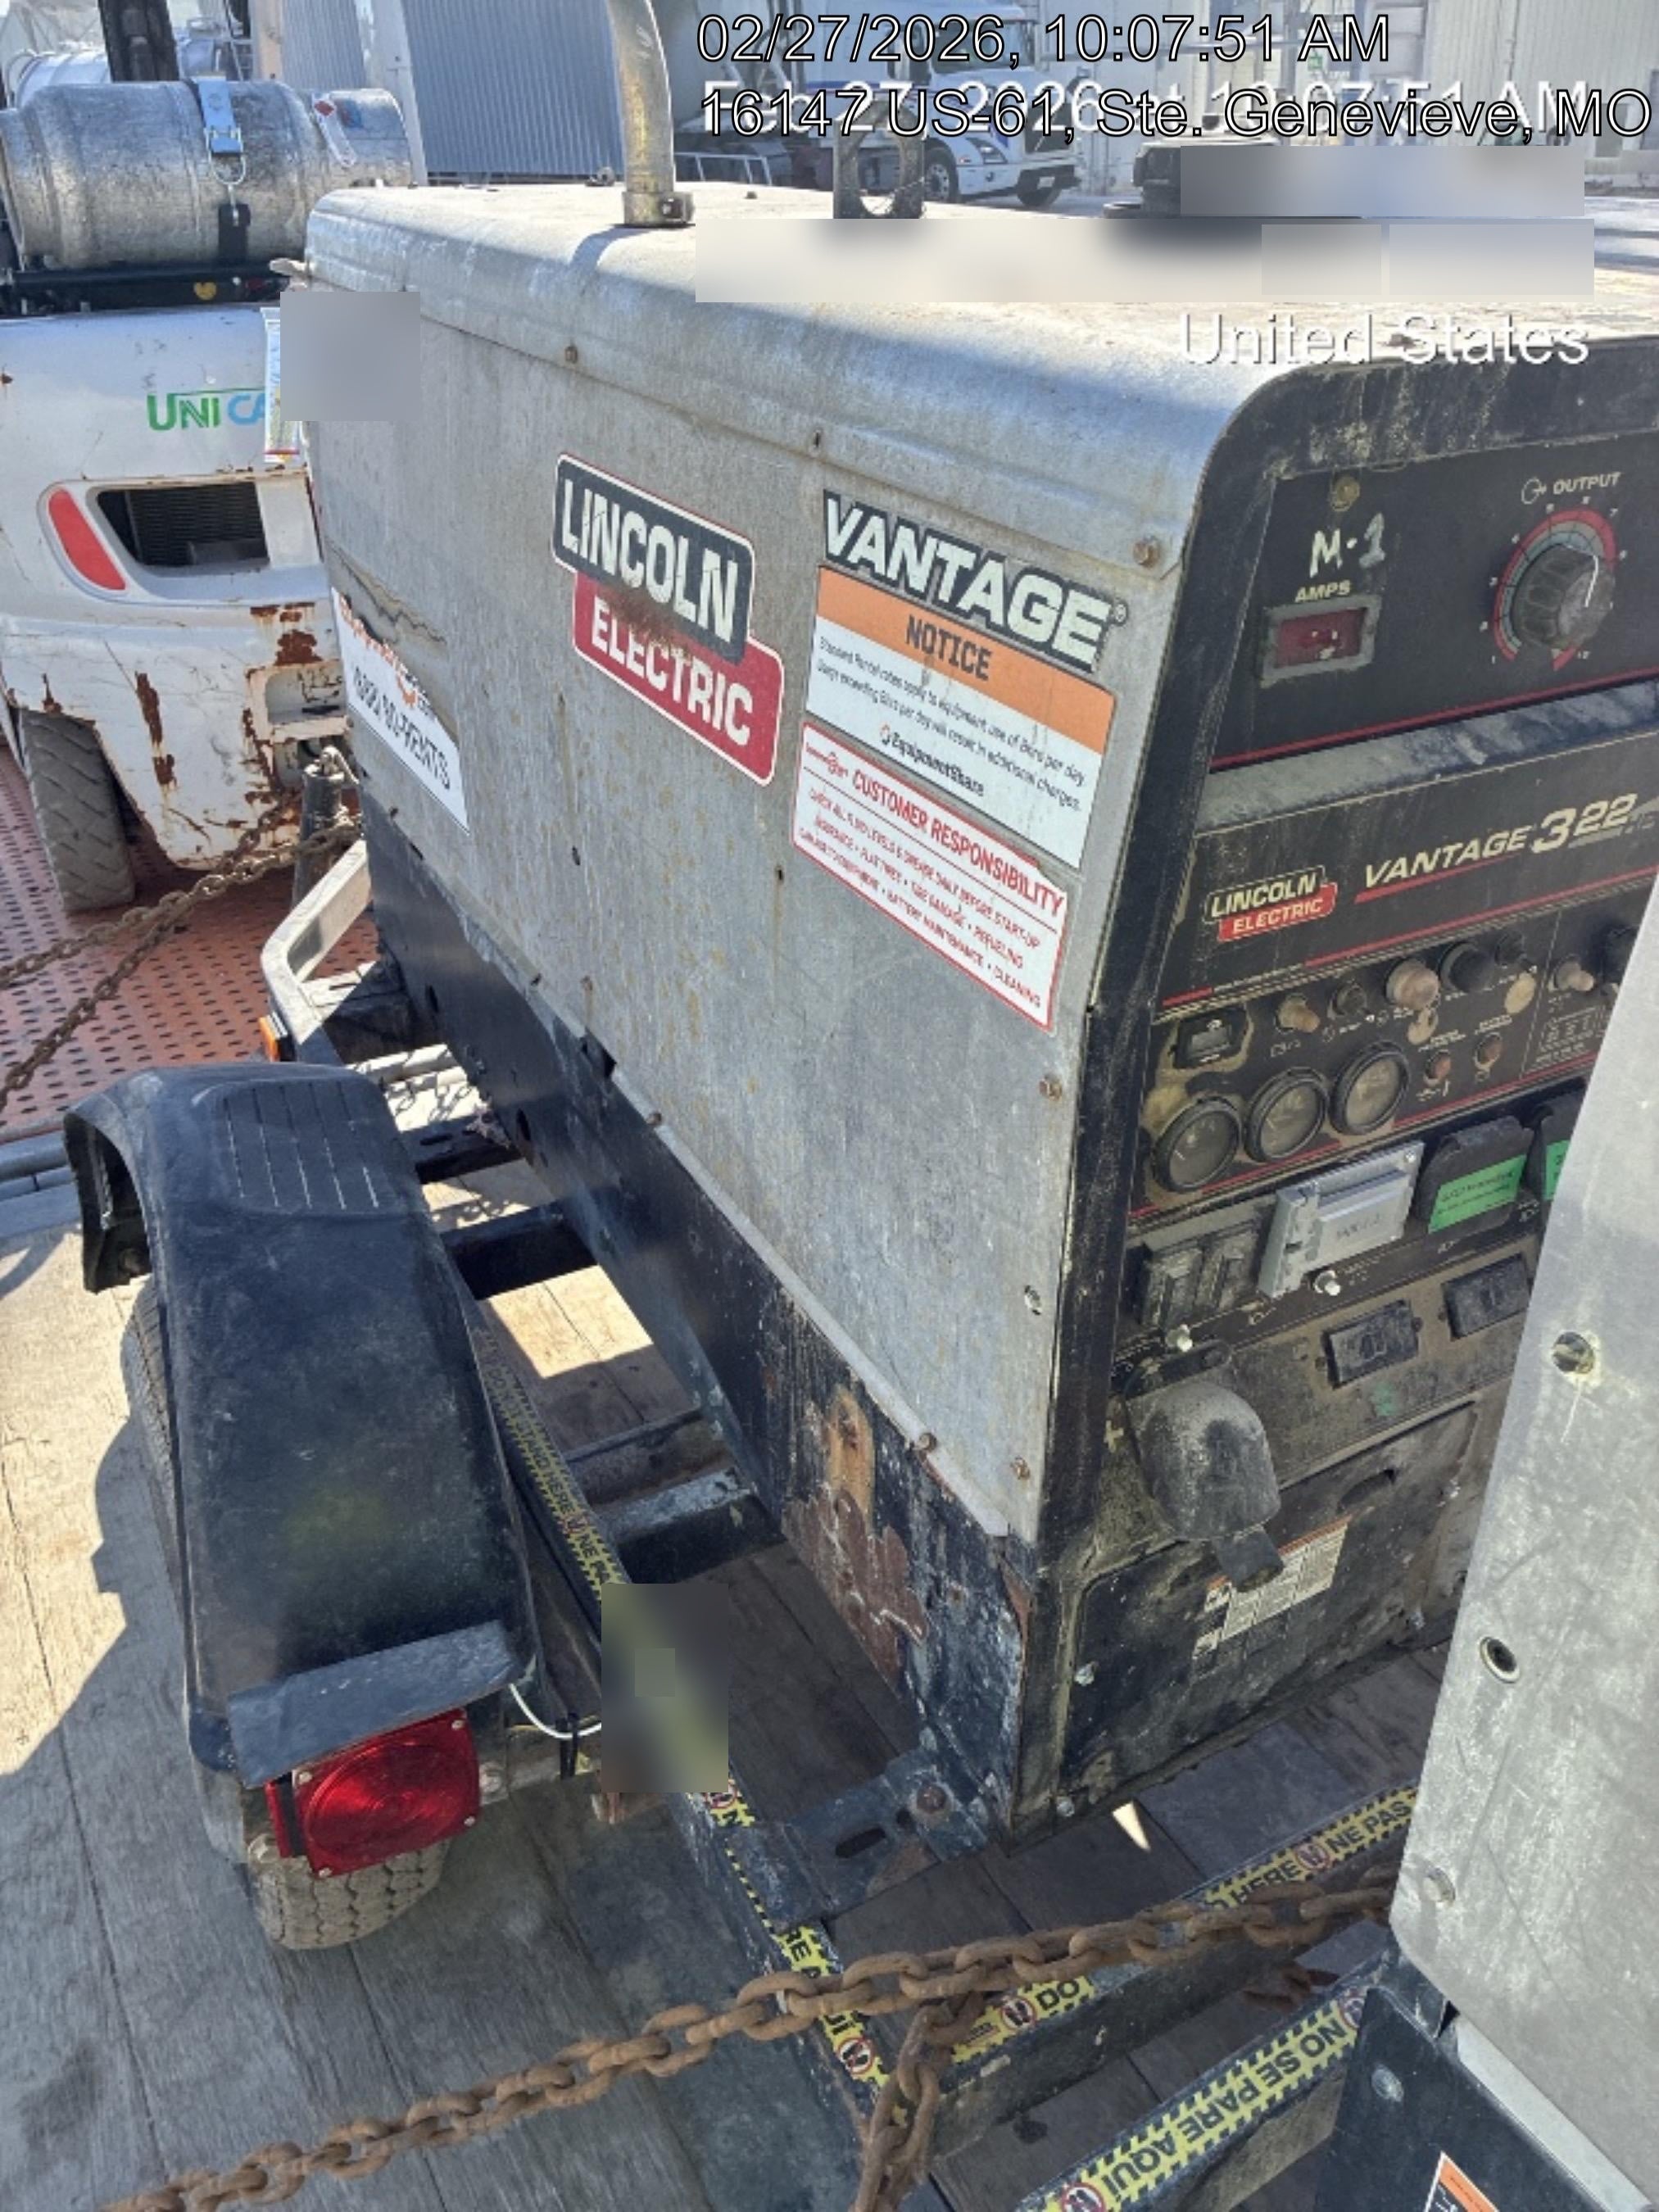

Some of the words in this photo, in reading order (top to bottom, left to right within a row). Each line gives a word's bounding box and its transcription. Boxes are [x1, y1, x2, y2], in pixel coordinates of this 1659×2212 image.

[1552, 471, 1623, 495] OUTPUT
[560, 477, 739, 643] LINCOLN
[823, 490, 1114, 673] VANTAGE
[1294, 578, 1352, 604] AMPS
[590, 595, 754, 747] ELECTRIC
[906, 614, 992, 682] NOTICE
[1064, 763, 1086, 786] day
[854, 768, 927, 833] CUSTOMER
[931, 815, 1064, 922] RESPONSIBILITY
[1363, 825, 1530, 890] VANTAGE
[1530, 791, 1639, 856] 322
[1209, 871, 1317, 918] LINCOLN
[1232, 899, 1324, 936] ELECTRIC
[1326, 1824, 1362, 1853] NE
[1366, 1800, 1412, 1834] PAS
[1299, 2021, 1346, 2058] NO
[1256, 2051, 1299, 2086] SE
[1181, 2081, 1256, 2144] PARE
